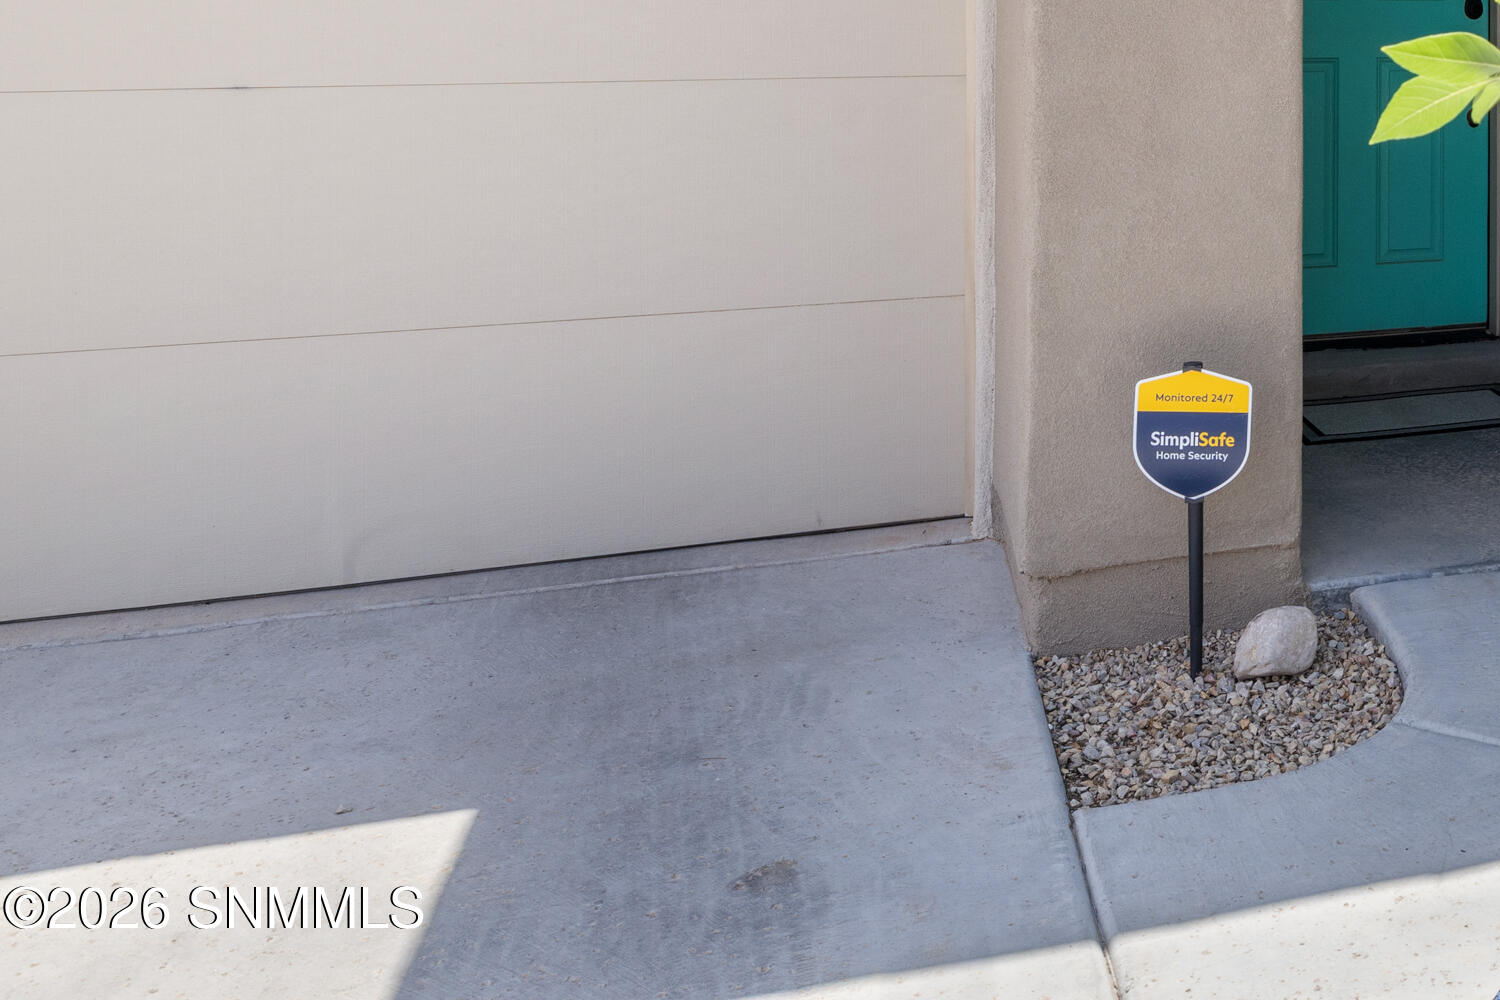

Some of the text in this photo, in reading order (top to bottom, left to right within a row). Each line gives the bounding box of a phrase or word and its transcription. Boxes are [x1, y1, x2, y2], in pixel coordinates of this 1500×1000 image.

[1155, 393, 1234, 403] Monitored 24/7
[1150, 431, 1235, 450] SimpliSafe
[1156, 451, 1228, 462] Home Security
